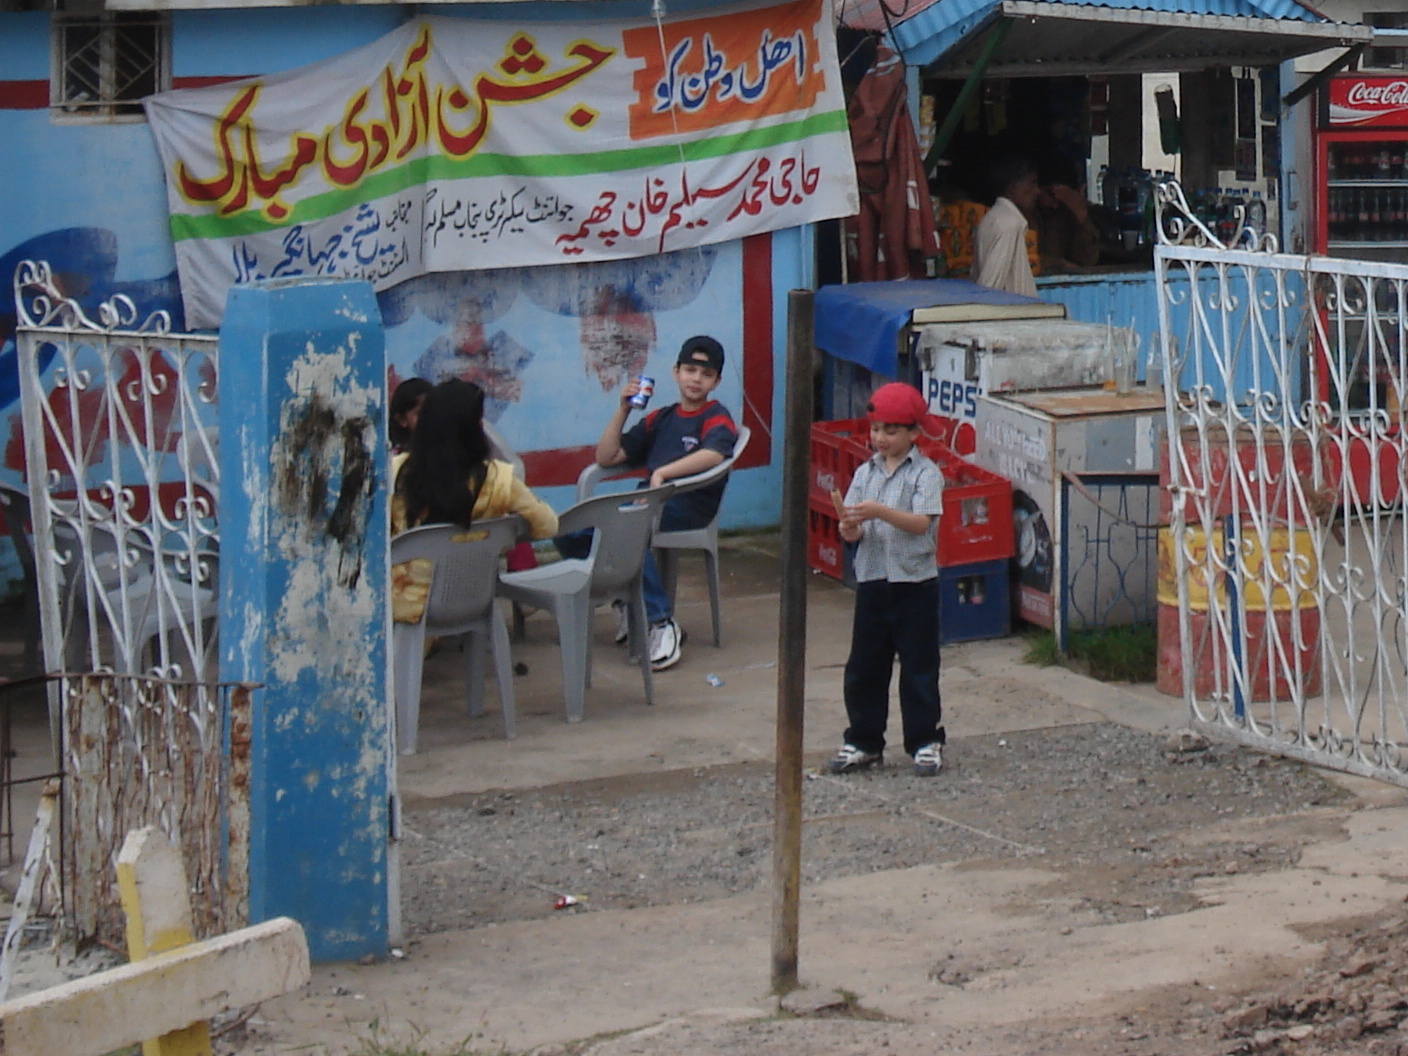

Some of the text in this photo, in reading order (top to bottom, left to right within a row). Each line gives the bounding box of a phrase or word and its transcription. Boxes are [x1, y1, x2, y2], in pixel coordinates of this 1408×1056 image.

[179, 27, 615, 219] جشن آزادی مبارک
[928, 377, 982, 419] PEPS
